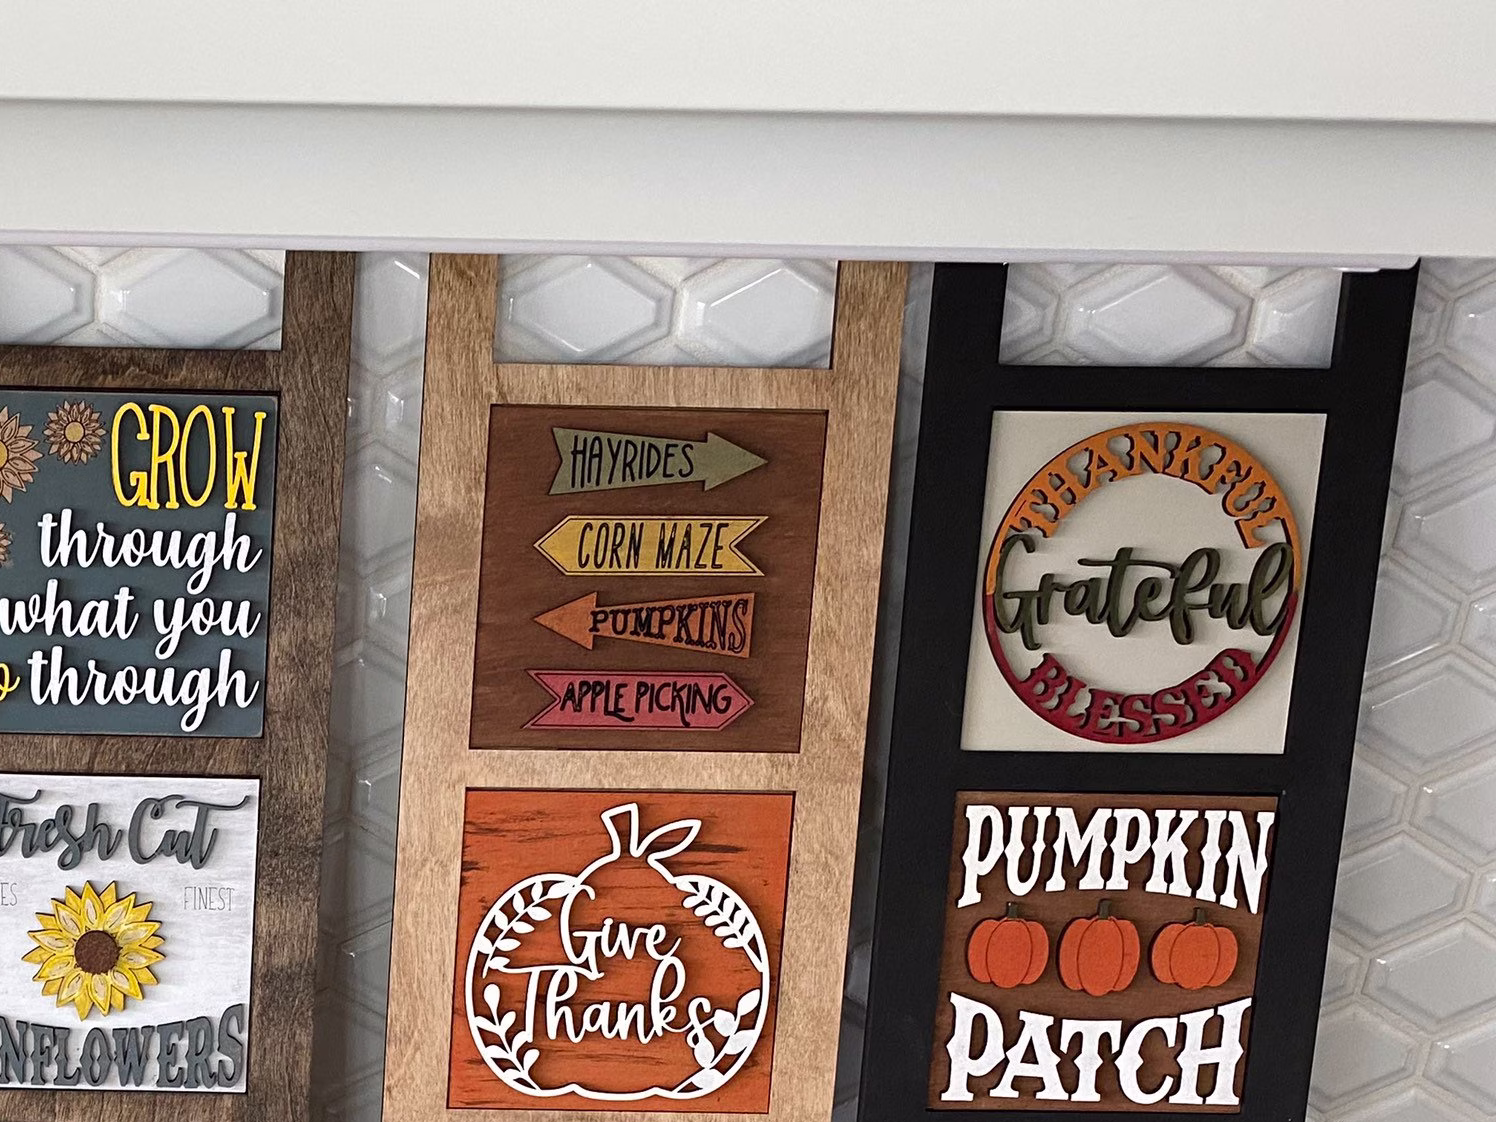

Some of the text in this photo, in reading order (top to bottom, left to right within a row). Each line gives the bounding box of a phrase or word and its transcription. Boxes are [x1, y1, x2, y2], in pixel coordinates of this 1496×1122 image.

[111, 402, 267, 510] GROW
[570, 435, 695, 488] HAYRIDES
[1004, 426, 1294, 549] THANKFUL
[38, 508, 263, 594] through
[577, 522, 730, 570] CORN MAZE
[153, 597, 262, 660] you
[588, 599, 749, 653] PUMPKINS
[993, 533, 1294, 651] Grateful
[27, 645, 260, 733] through
[559, 680, 732, 728] APPLE PICKING
[1018, 648, 1257, 739] BLESSED
[183, 886, 236, 912] FINEST
[957, 804, 1276, 915] PUMPKIN
[560, 882, 681, 981] Give
[502, 955, 718, 1049] Thanks
[940, 991, 1253, 1105] PATCH
